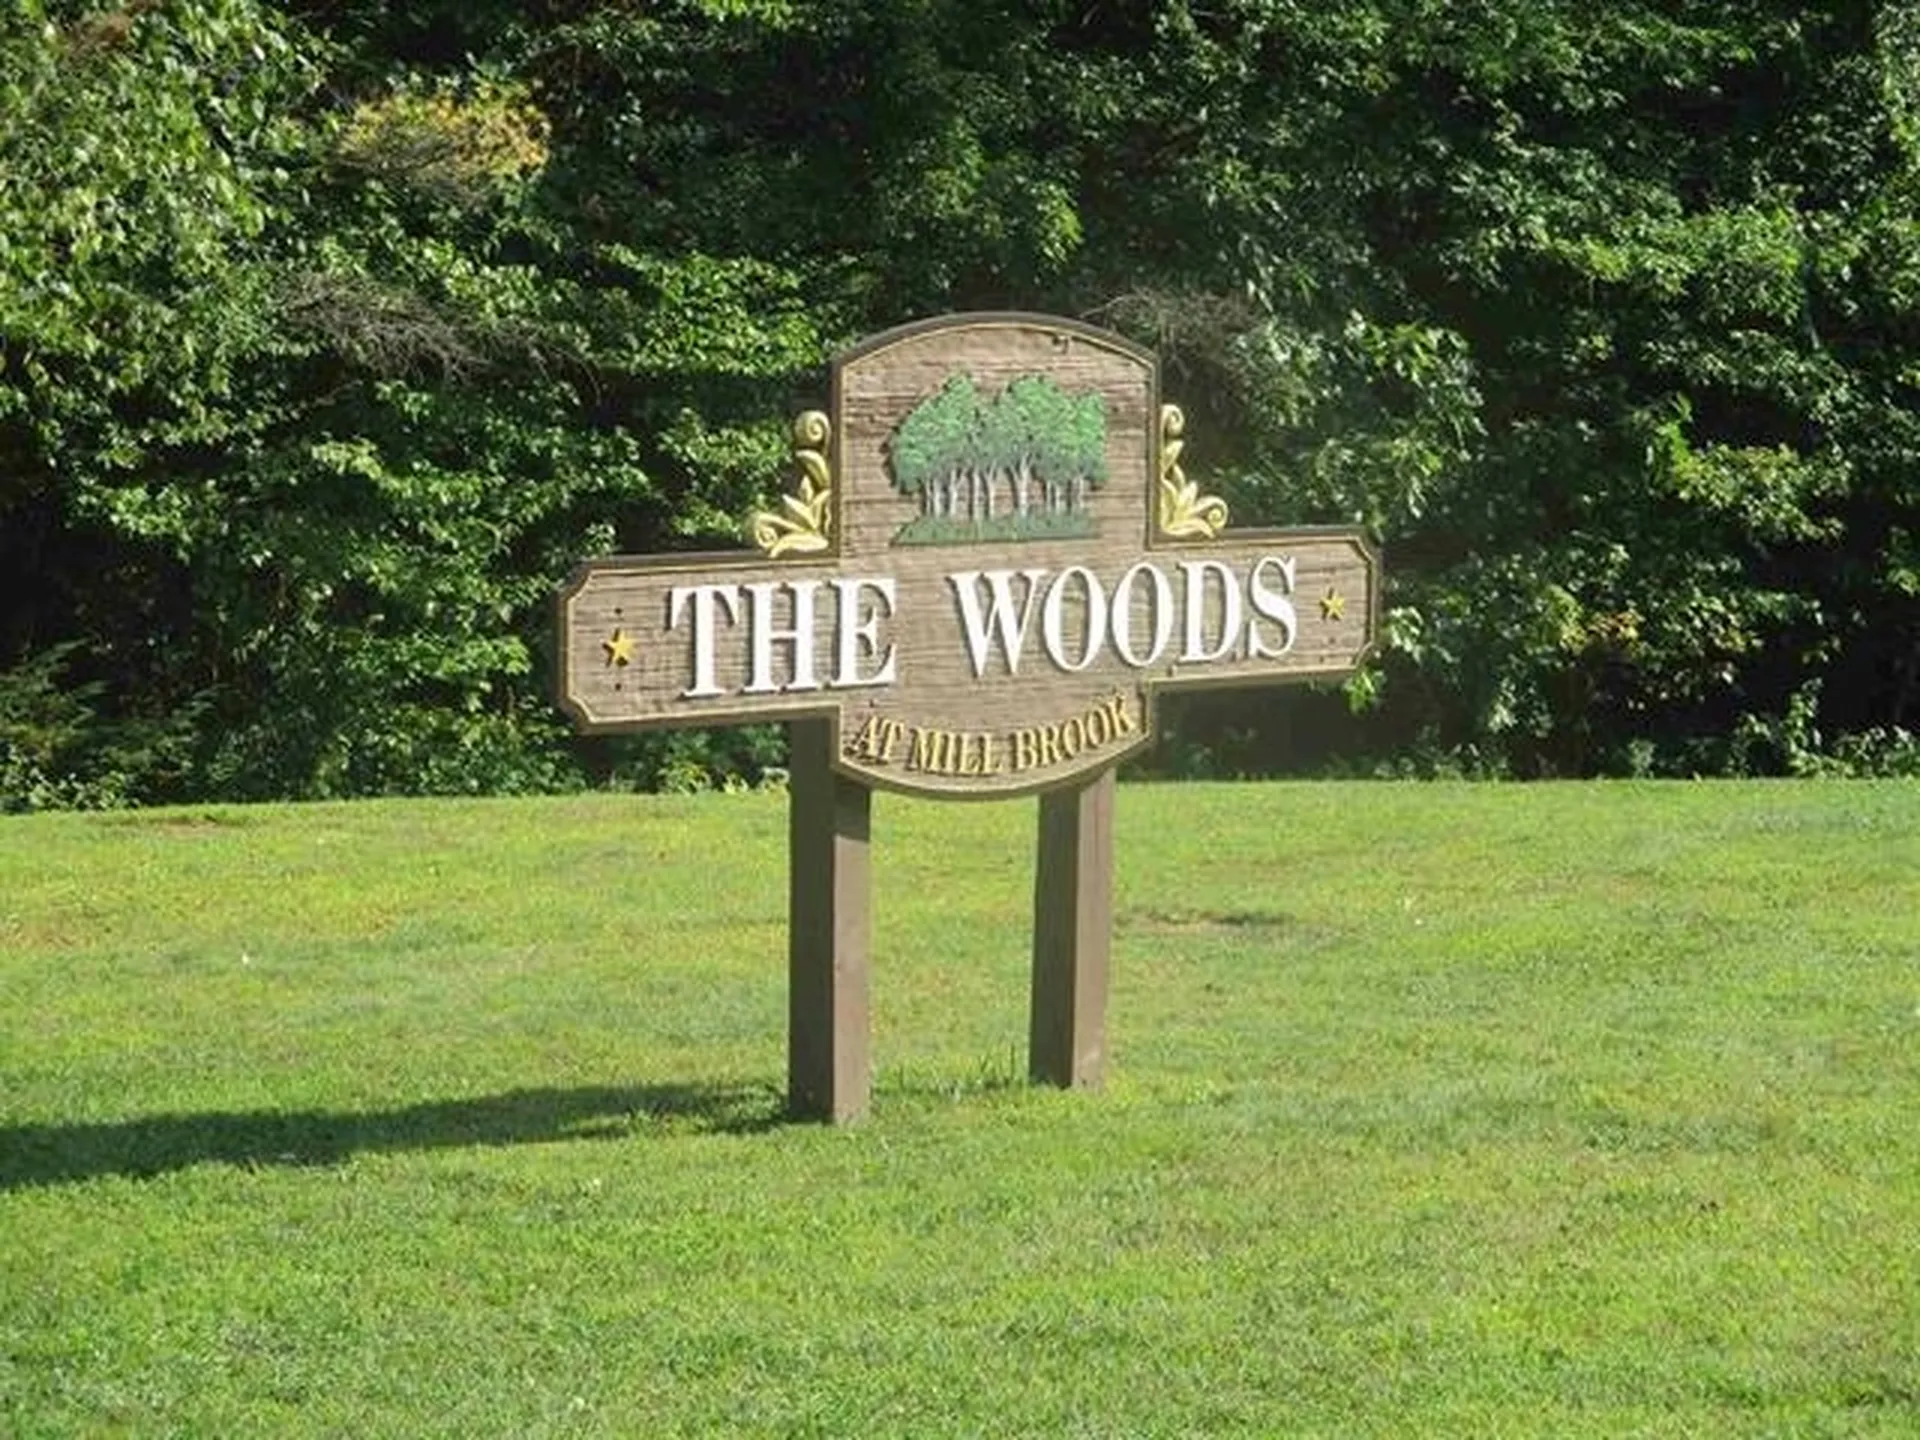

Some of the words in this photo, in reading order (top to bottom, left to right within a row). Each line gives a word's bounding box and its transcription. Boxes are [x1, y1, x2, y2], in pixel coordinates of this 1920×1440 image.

[669, 578, 897, 698] THE
[948, 555, 1298, 678] WOODS
[848, 714, 905, 764] AT
[905, 727, 1004, 774] MILL
[1009, 695, 1137, 772] BROOK
